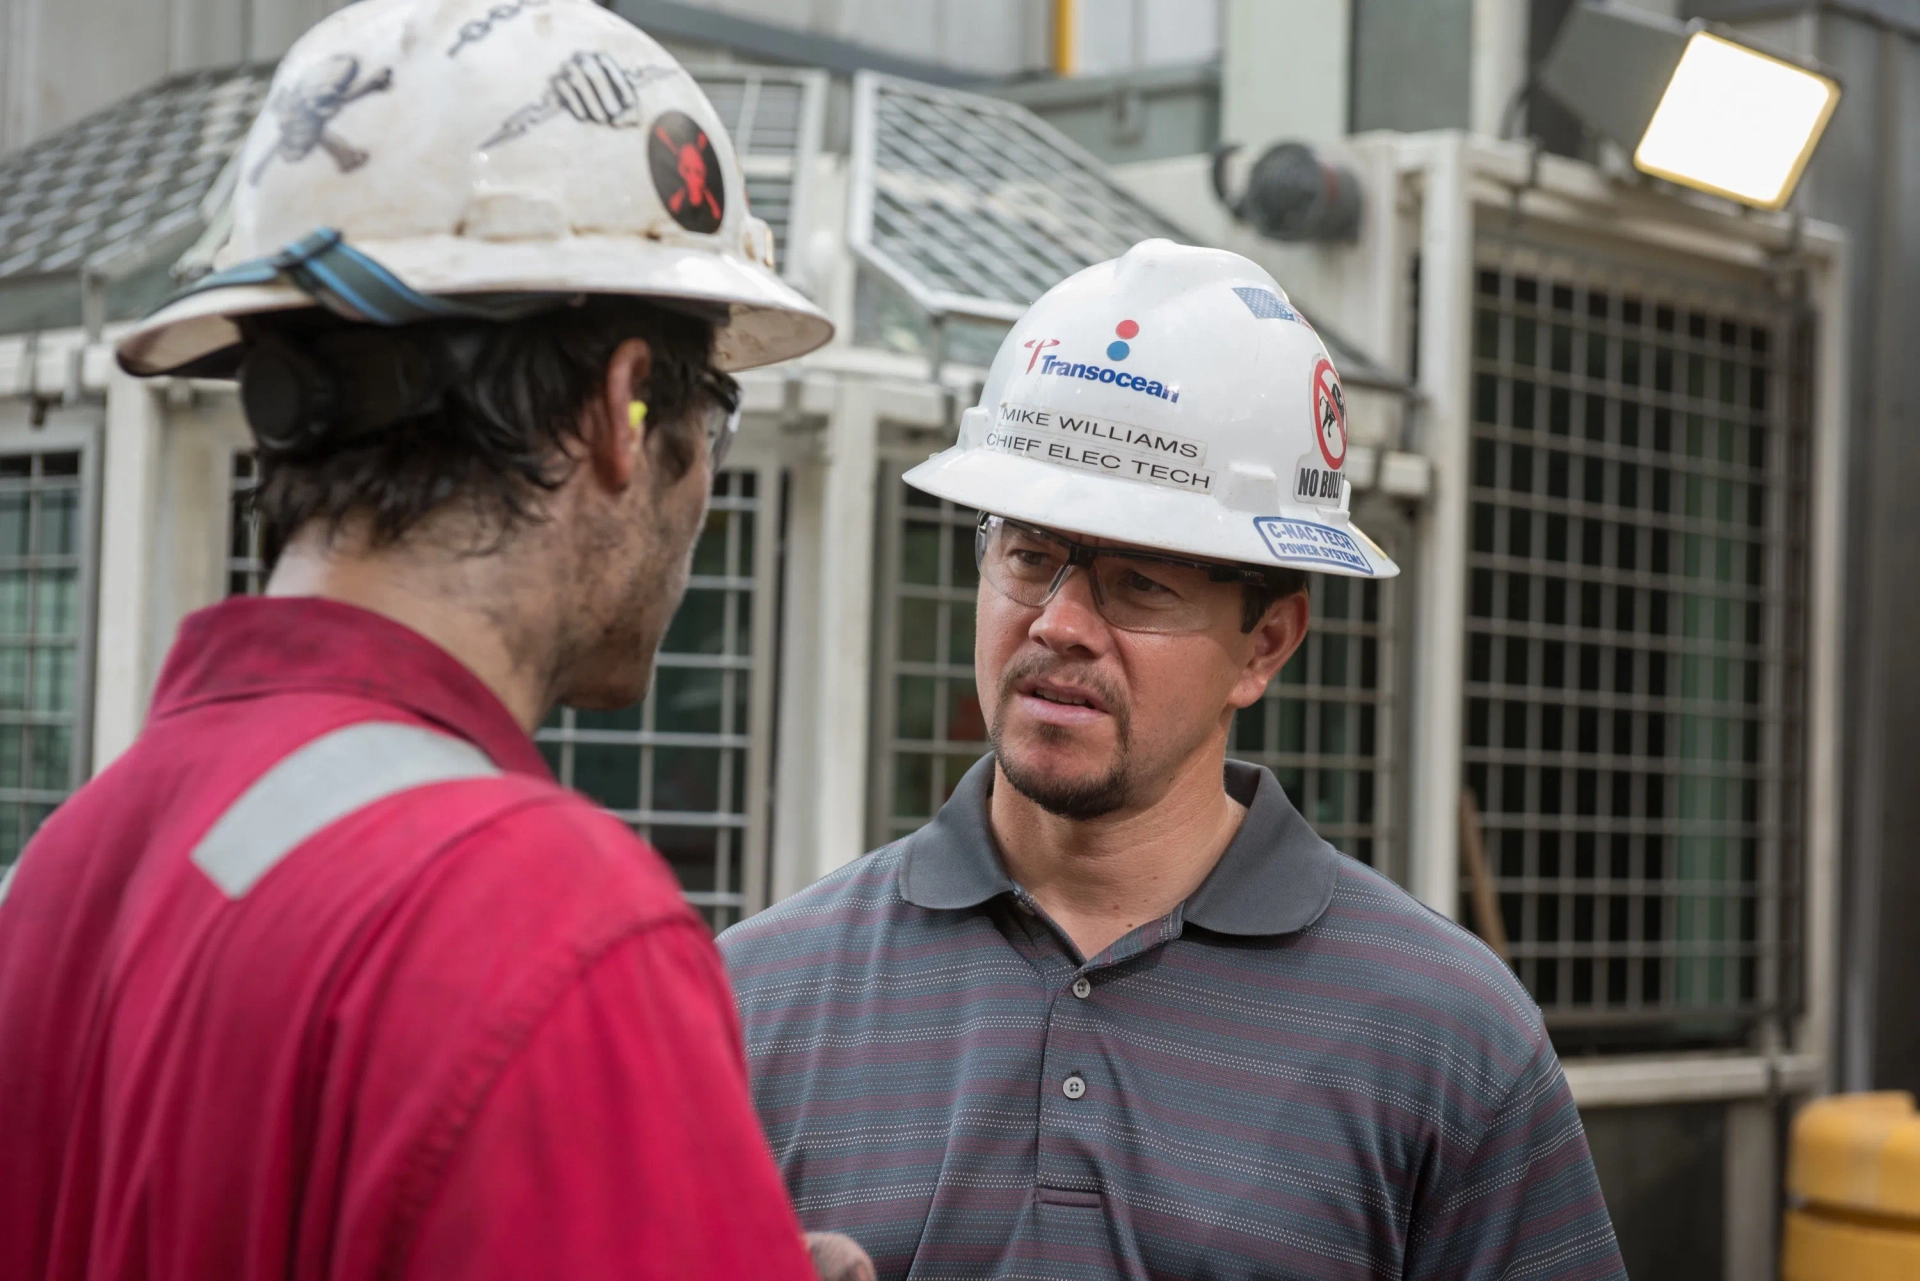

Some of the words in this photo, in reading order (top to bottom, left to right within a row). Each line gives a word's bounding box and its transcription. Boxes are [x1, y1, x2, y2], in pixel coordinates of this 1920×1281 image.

[1040, 355, 1180, 404] Transocean
[1002, 407, 1051, 427] MIKE
[1059, 416, 1198, 459] WILLIAMS
[986, 433, 1042, 451] CHIEF
[1048, 443, 1121, 469] ELEC
[1131, 460, 1210, 489] TECH
[1298, 467, 1320, 498] NO
[1267, 523, 1319, 542] C-NAC
[1317, 529, 1355, 552] TECH
[1278, 543, 1321, 557] POWER
[1319, 546, 1365, 567] SYSTEMS
